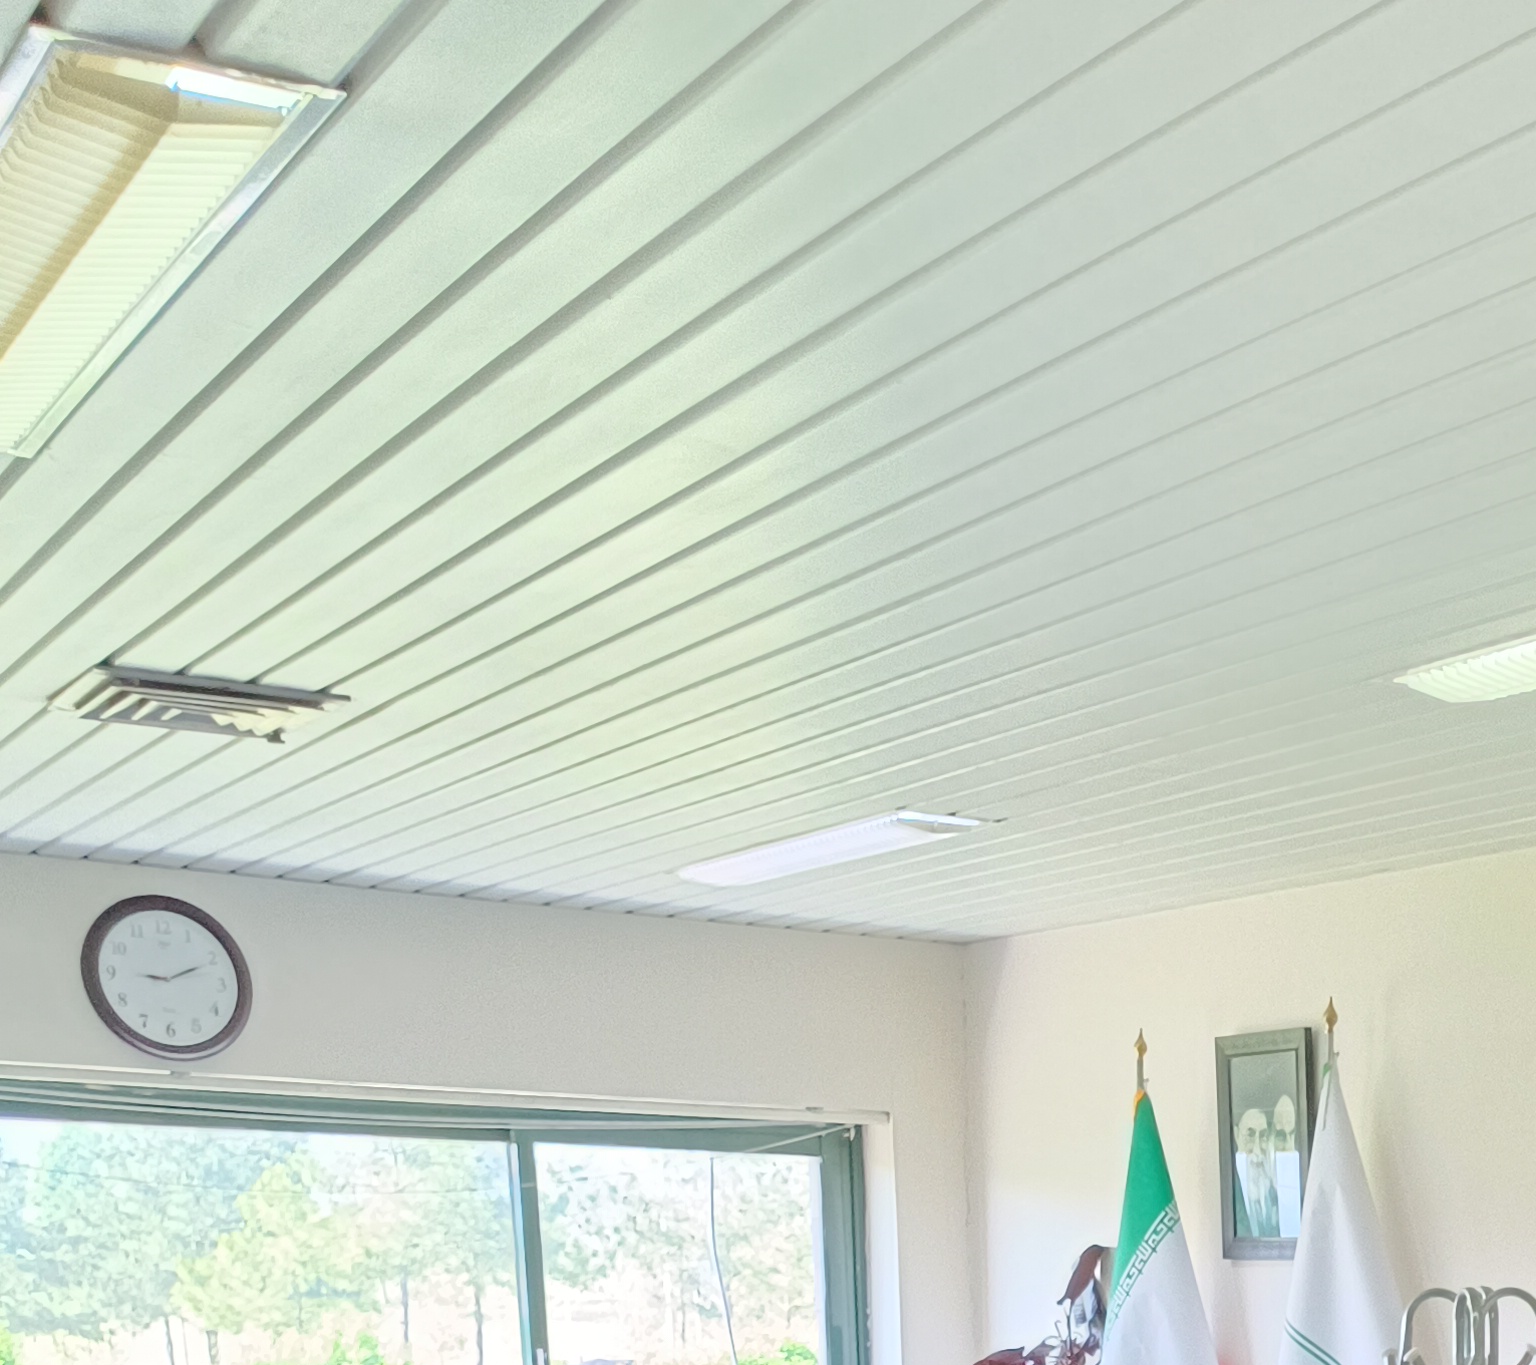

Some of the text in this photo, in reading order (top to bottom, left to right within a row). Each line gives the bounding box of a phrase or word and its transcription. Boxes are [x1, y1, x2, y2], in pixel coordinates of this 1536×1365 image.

[130, 924, 144, 939] 11
[155, 920, 173, 935] 12
[185, 929, 192, 943] 1
[111, 941, 127, 956] 10
[207, 951, 218, 966] 2
[106, 965, 116, 981] 9
[216, 977, 227, 993] 3
[117, 992, 128, 1007] 8
[209, 1001, 220, 1017] 4
[139, 1013, 149, 1029] 7
[166, 1021, 176, 1038] 6
